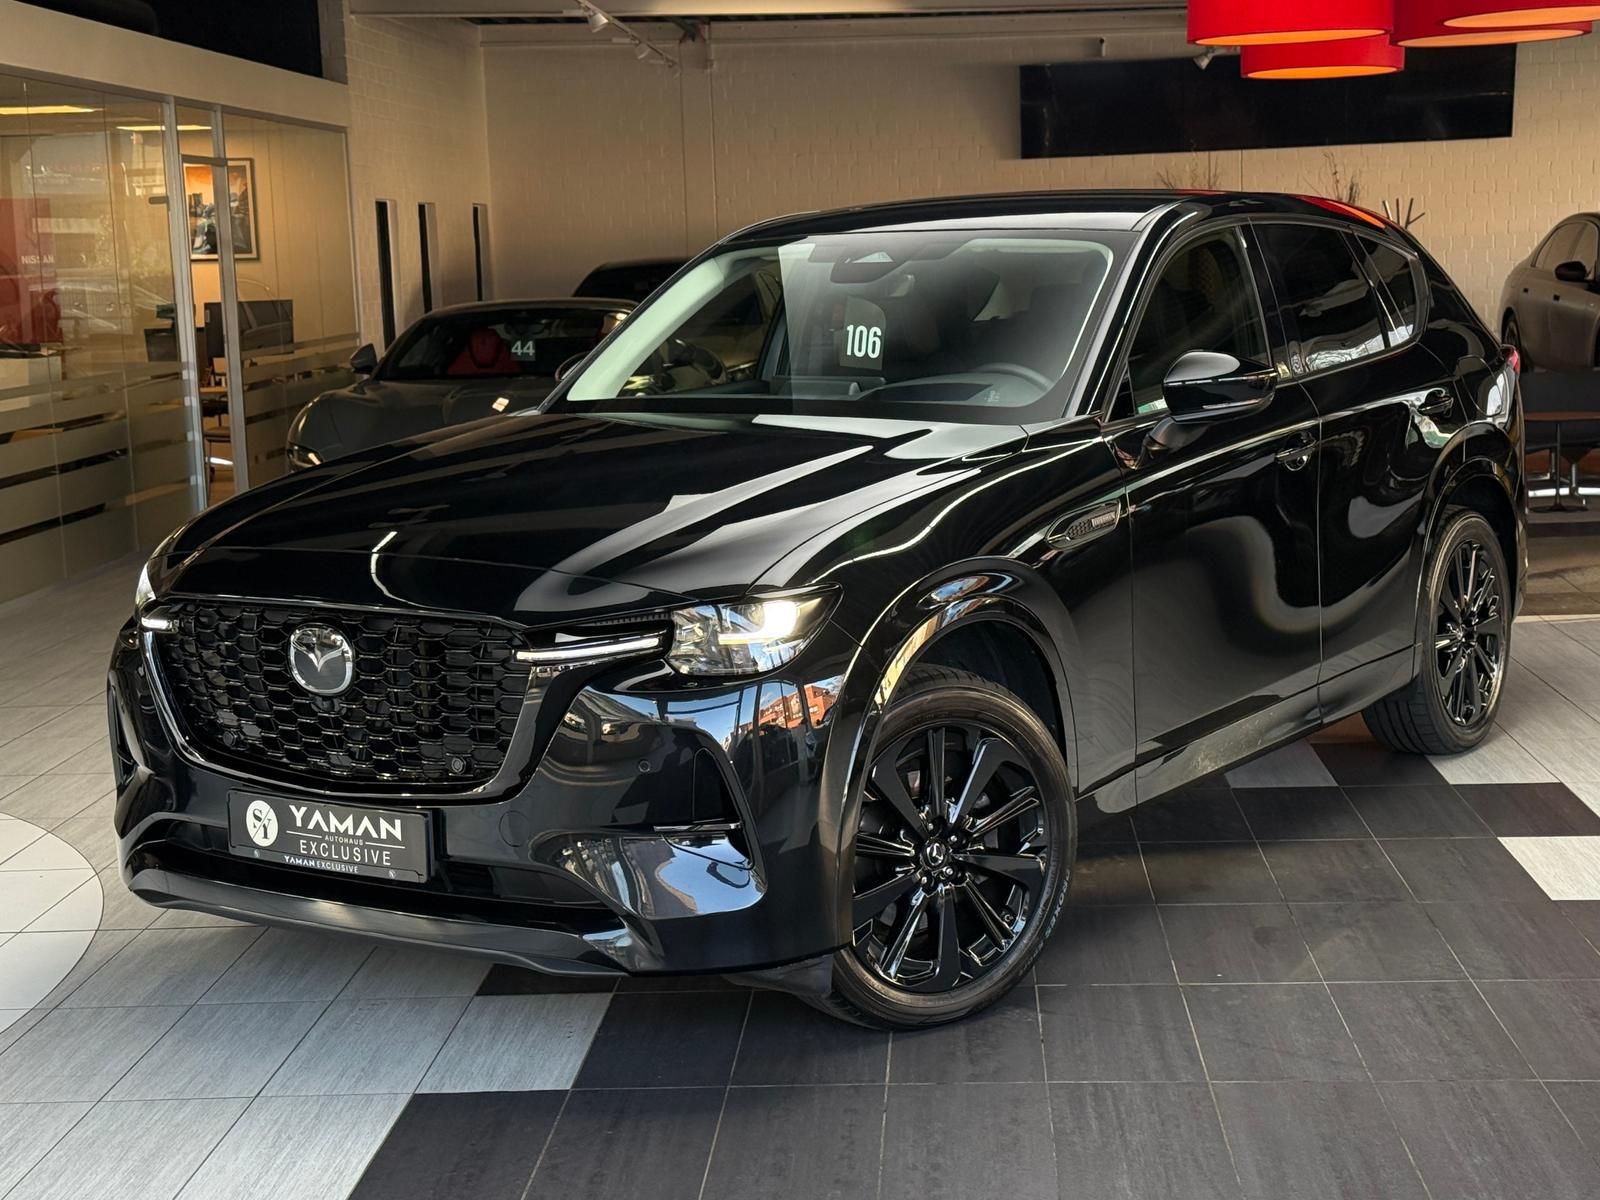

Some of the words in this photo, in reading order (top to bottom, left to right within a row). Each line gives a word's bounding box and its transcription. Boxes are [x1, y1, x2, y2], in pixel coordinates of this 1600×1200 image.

[511, 340, 536, 356] 44
[846, 324, 882, 359] 106
[288, 804, 402, 842] YAMAN
[324, 834, 364, 846] AUTOHAUS
[299, 839, 392, 866] EXCLUSIVE
[284, 855, 316, 868] YAMAN
[316, 860, 359, 874] EXCLUSIVE
